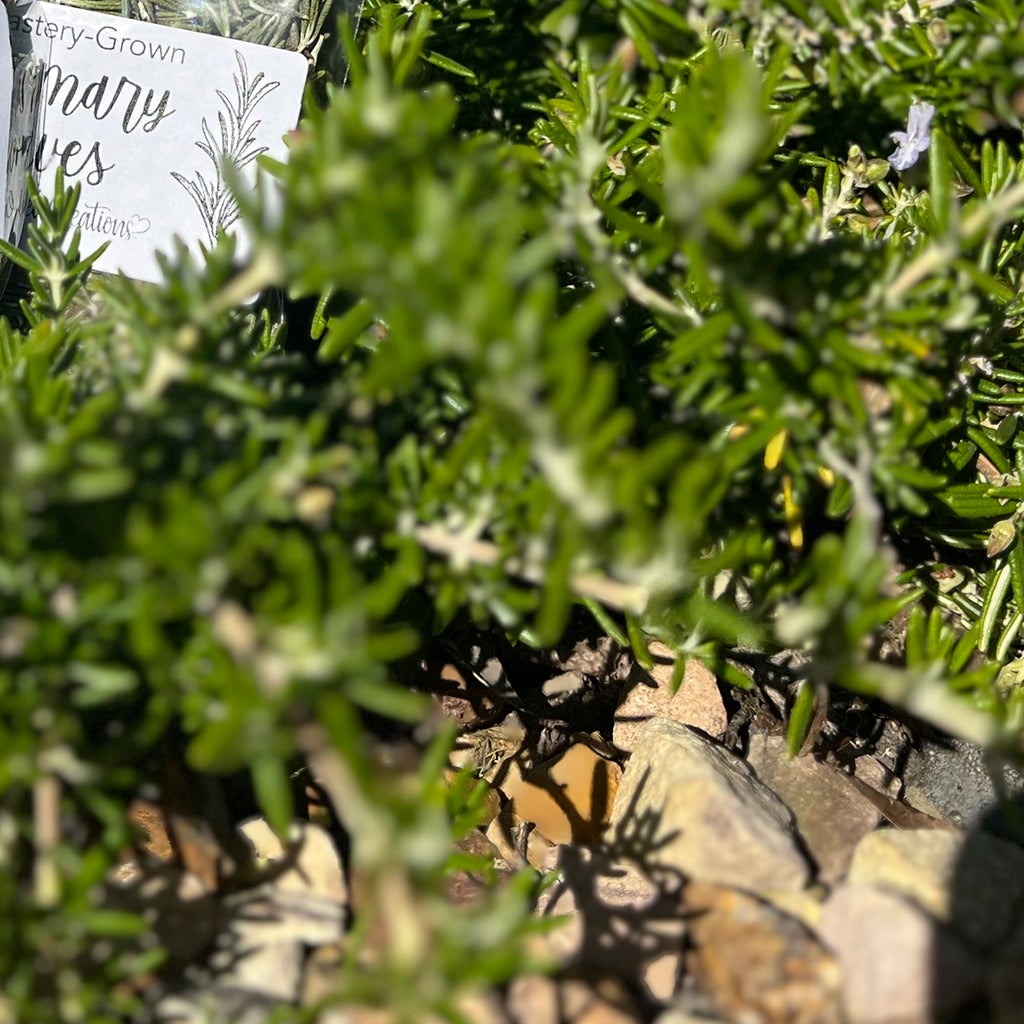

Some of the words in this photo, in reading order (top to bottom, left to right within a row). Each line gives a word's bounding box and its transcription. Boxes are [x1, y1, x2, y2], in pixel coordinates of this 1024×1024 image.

[9, 15, 186, 65] astery-Grown
[35, 59, 176, 134] mary
[34, 134, 115, 186] ves
[69, 201, 131, 240] eations
